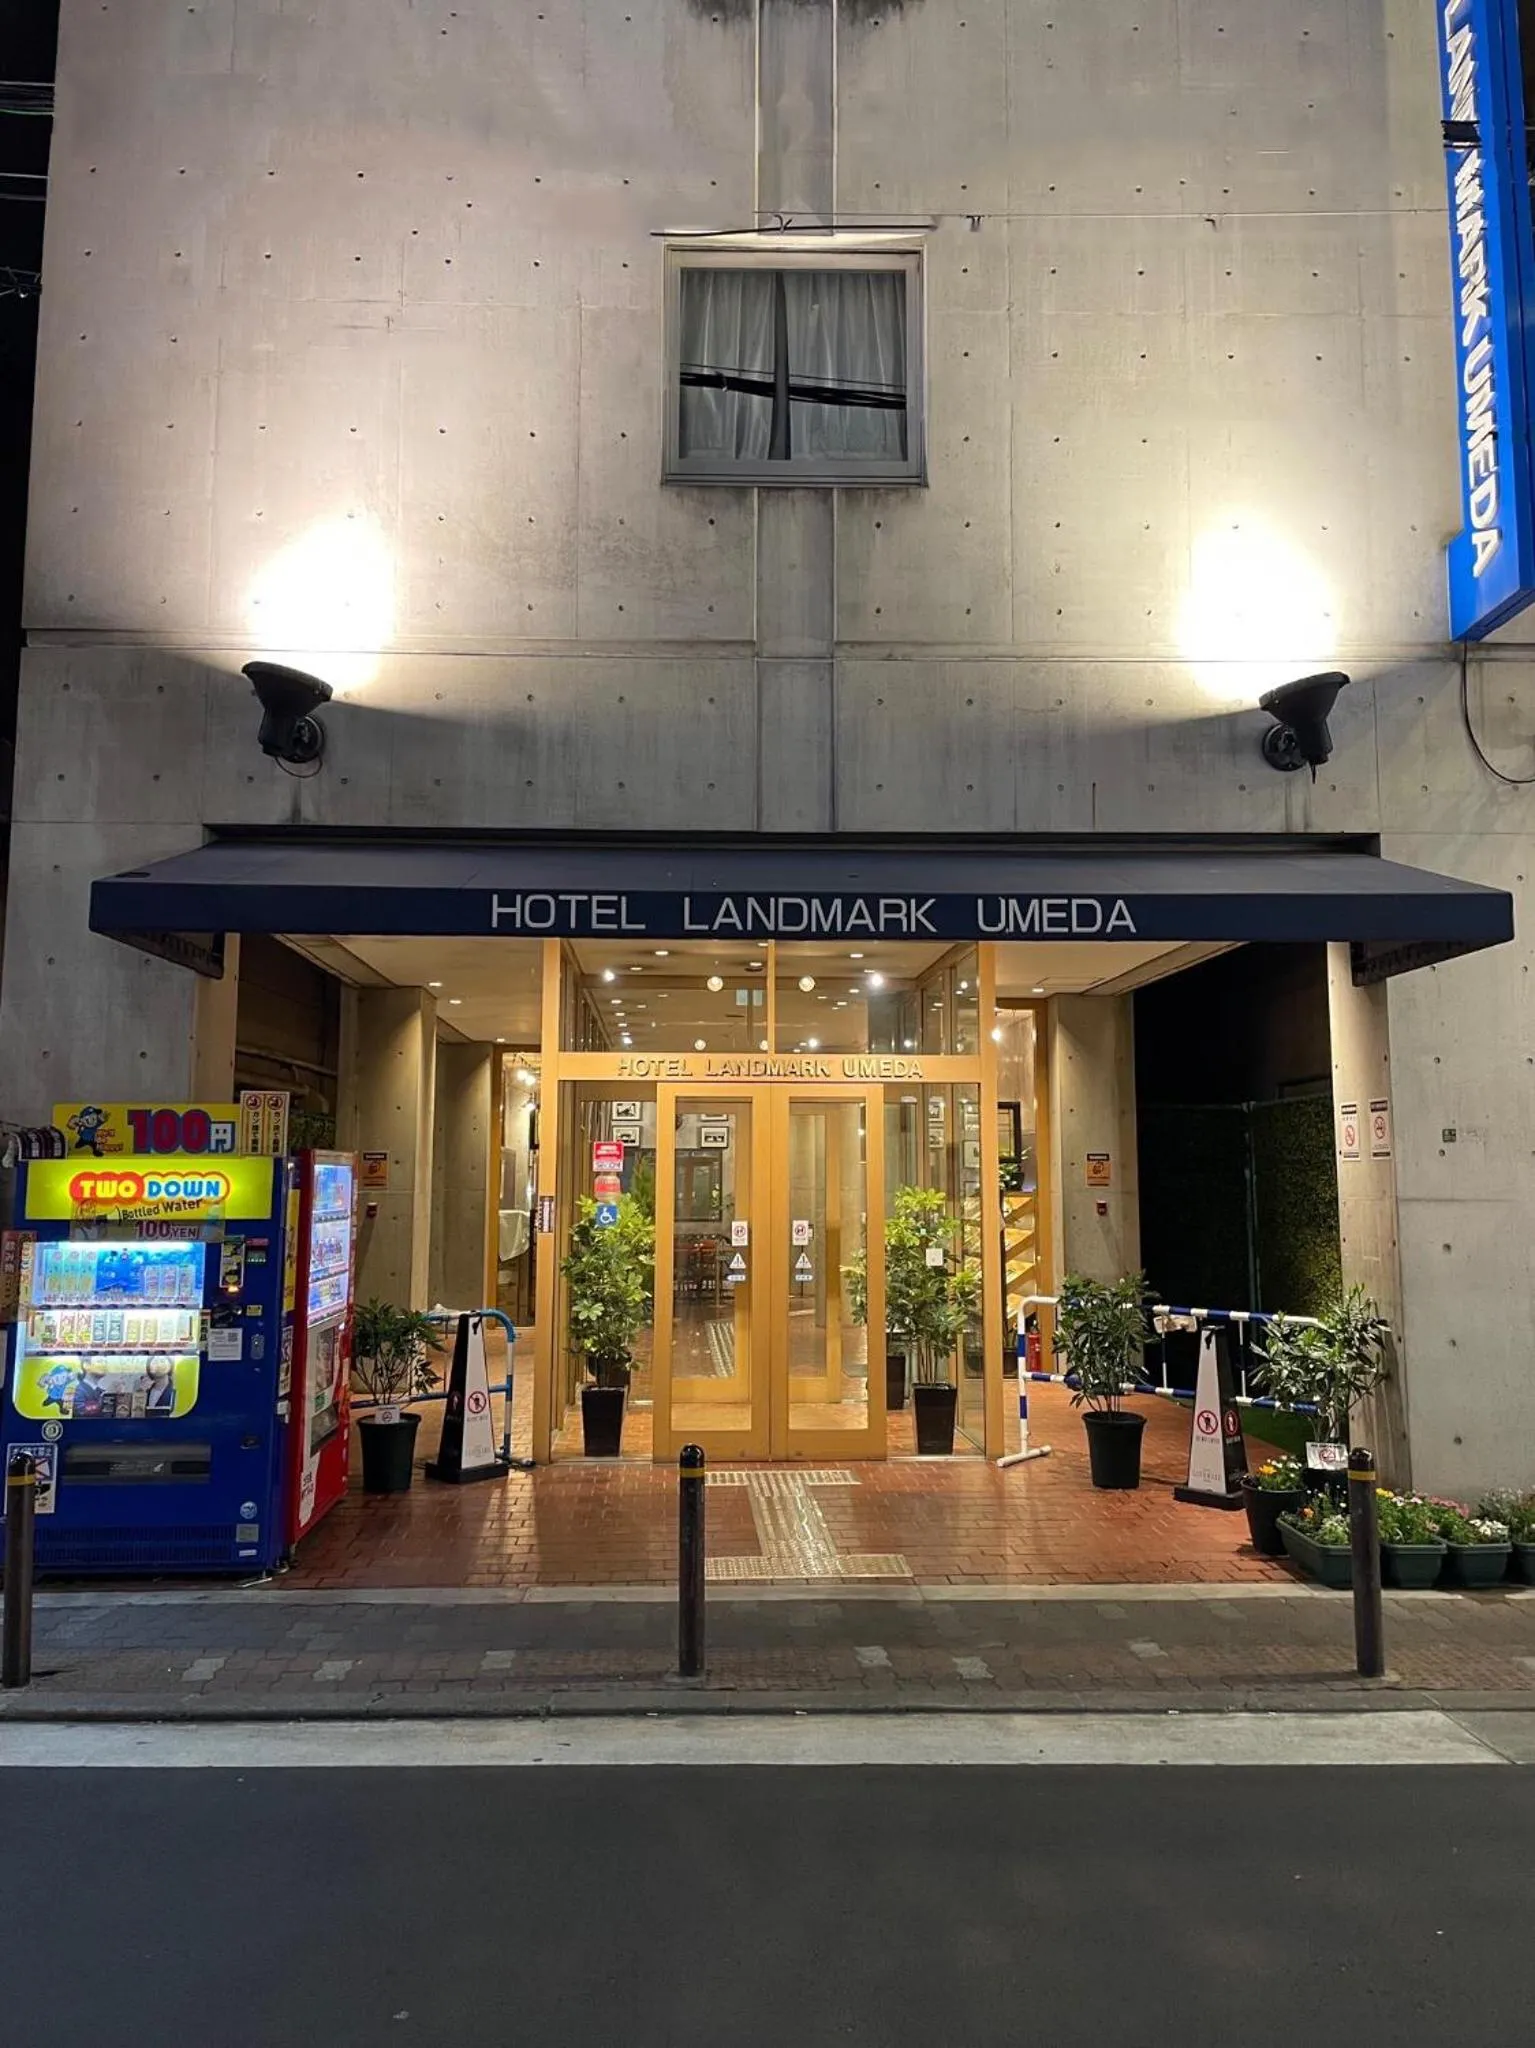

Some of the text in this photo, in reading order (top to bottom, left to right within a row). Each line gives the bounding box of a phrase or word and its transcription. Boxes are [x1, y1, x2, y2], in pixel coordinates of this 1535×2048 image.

[1463, 343, 1501, 579] UMEDA
[490, 893, 1137, 935] HOTEL LANDMARK UMEDA
[618, 1058, 924, 1079] HOTEL LANDMARK UMEDA
[127, 1108, 236, 1155] 100円
[79, 1179, 221, 1198] TWO DOWN
[121, 1199, 203, 1221] Bottled Water
[134, 1220, 172, 1239] 100
